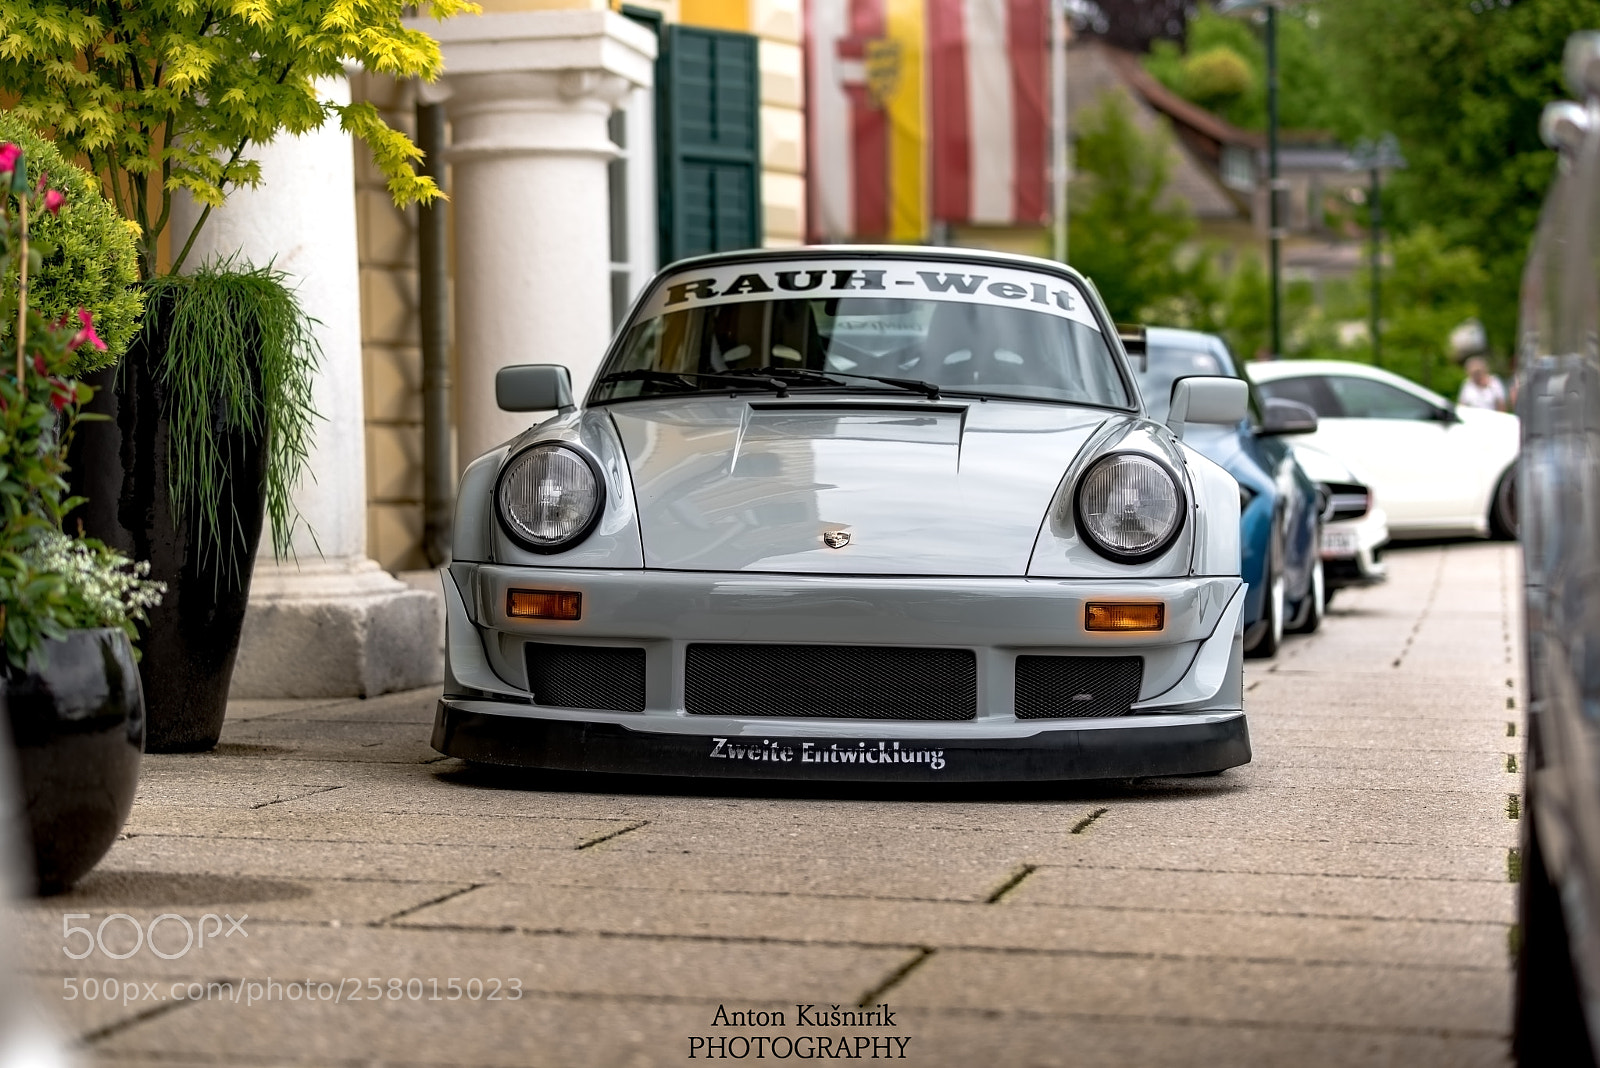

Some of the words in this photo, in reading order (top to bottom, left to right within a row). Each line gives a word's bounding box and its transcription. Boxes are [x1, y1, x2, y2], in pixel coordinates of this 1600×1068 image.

[664, 269, 1075, 312] RAUH-Welt
[709, 738, 794, 762] Zweite
[801, 741, 946, 770] Entwicklung
